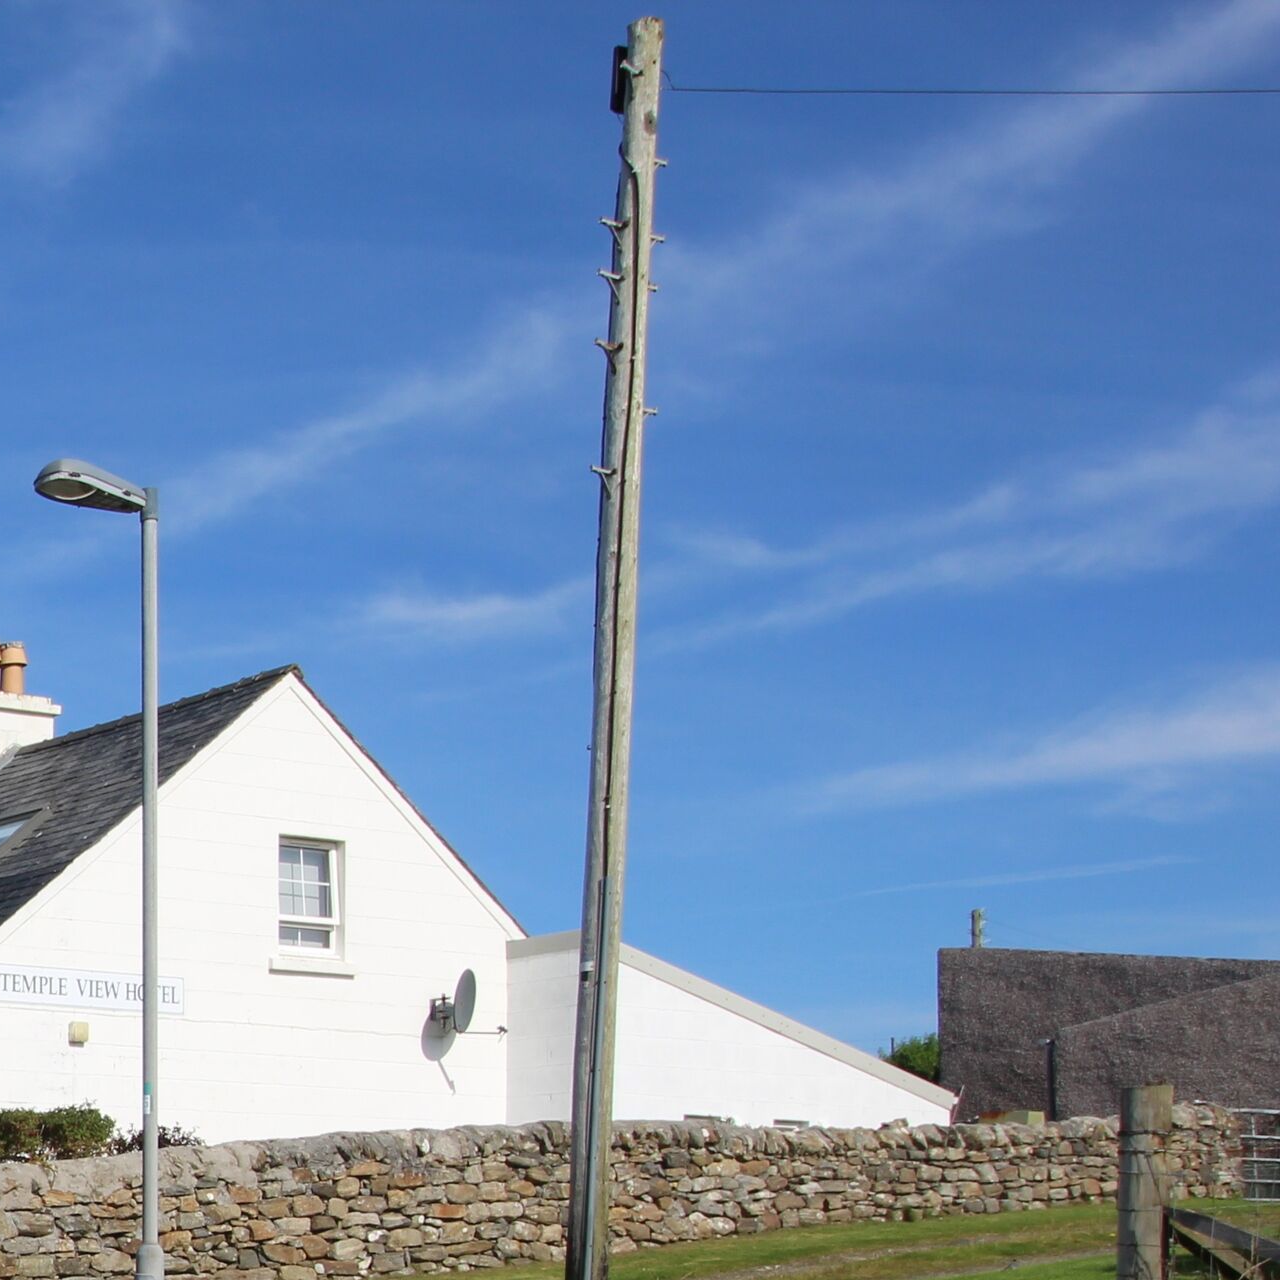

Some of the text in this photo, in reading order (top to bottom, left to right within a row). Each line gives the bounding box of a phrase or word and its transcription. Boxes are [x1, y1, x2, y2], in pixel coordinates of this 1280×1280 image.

[0, 973, 181, 1005] TEMPLE VIEW HEL
